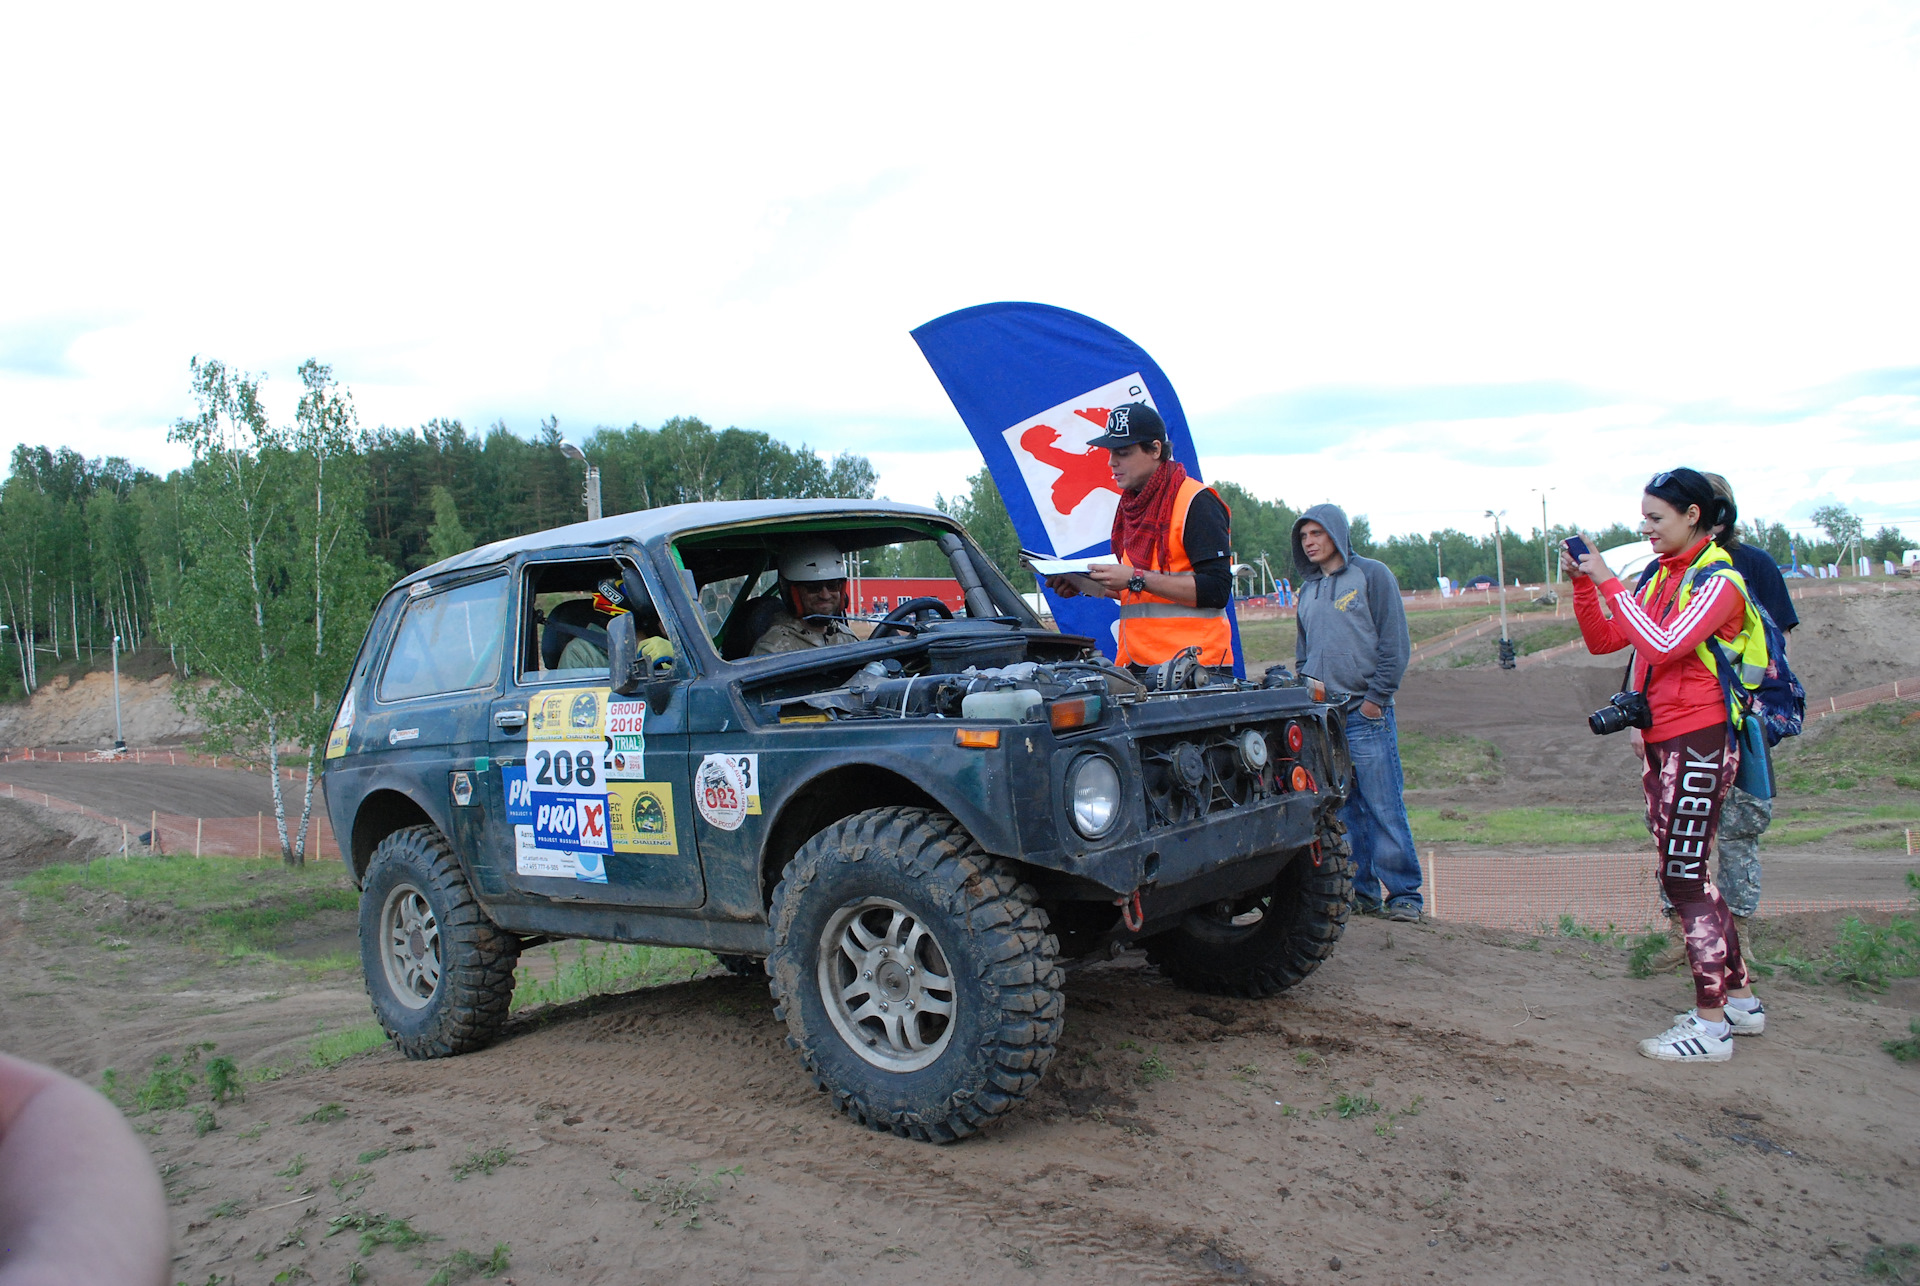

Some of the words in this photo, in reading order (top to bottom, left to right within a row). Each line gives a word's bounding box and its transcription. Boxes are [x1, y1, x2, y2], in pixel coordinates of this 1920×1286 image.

[601, 585, 621, 602] agv
[610, 702, 646, 716] GROUP
[610, 717, 643, 732] 2018
[615, 736, 639, 751] TRIAL
[534, 749, 596, 787] 208
[508, 779, 531, 807] PR
[705, 787, 738, 809] 023
[536, 804, 576, 836] PRO
[1666, 745, 1721, 880] REEBOK
